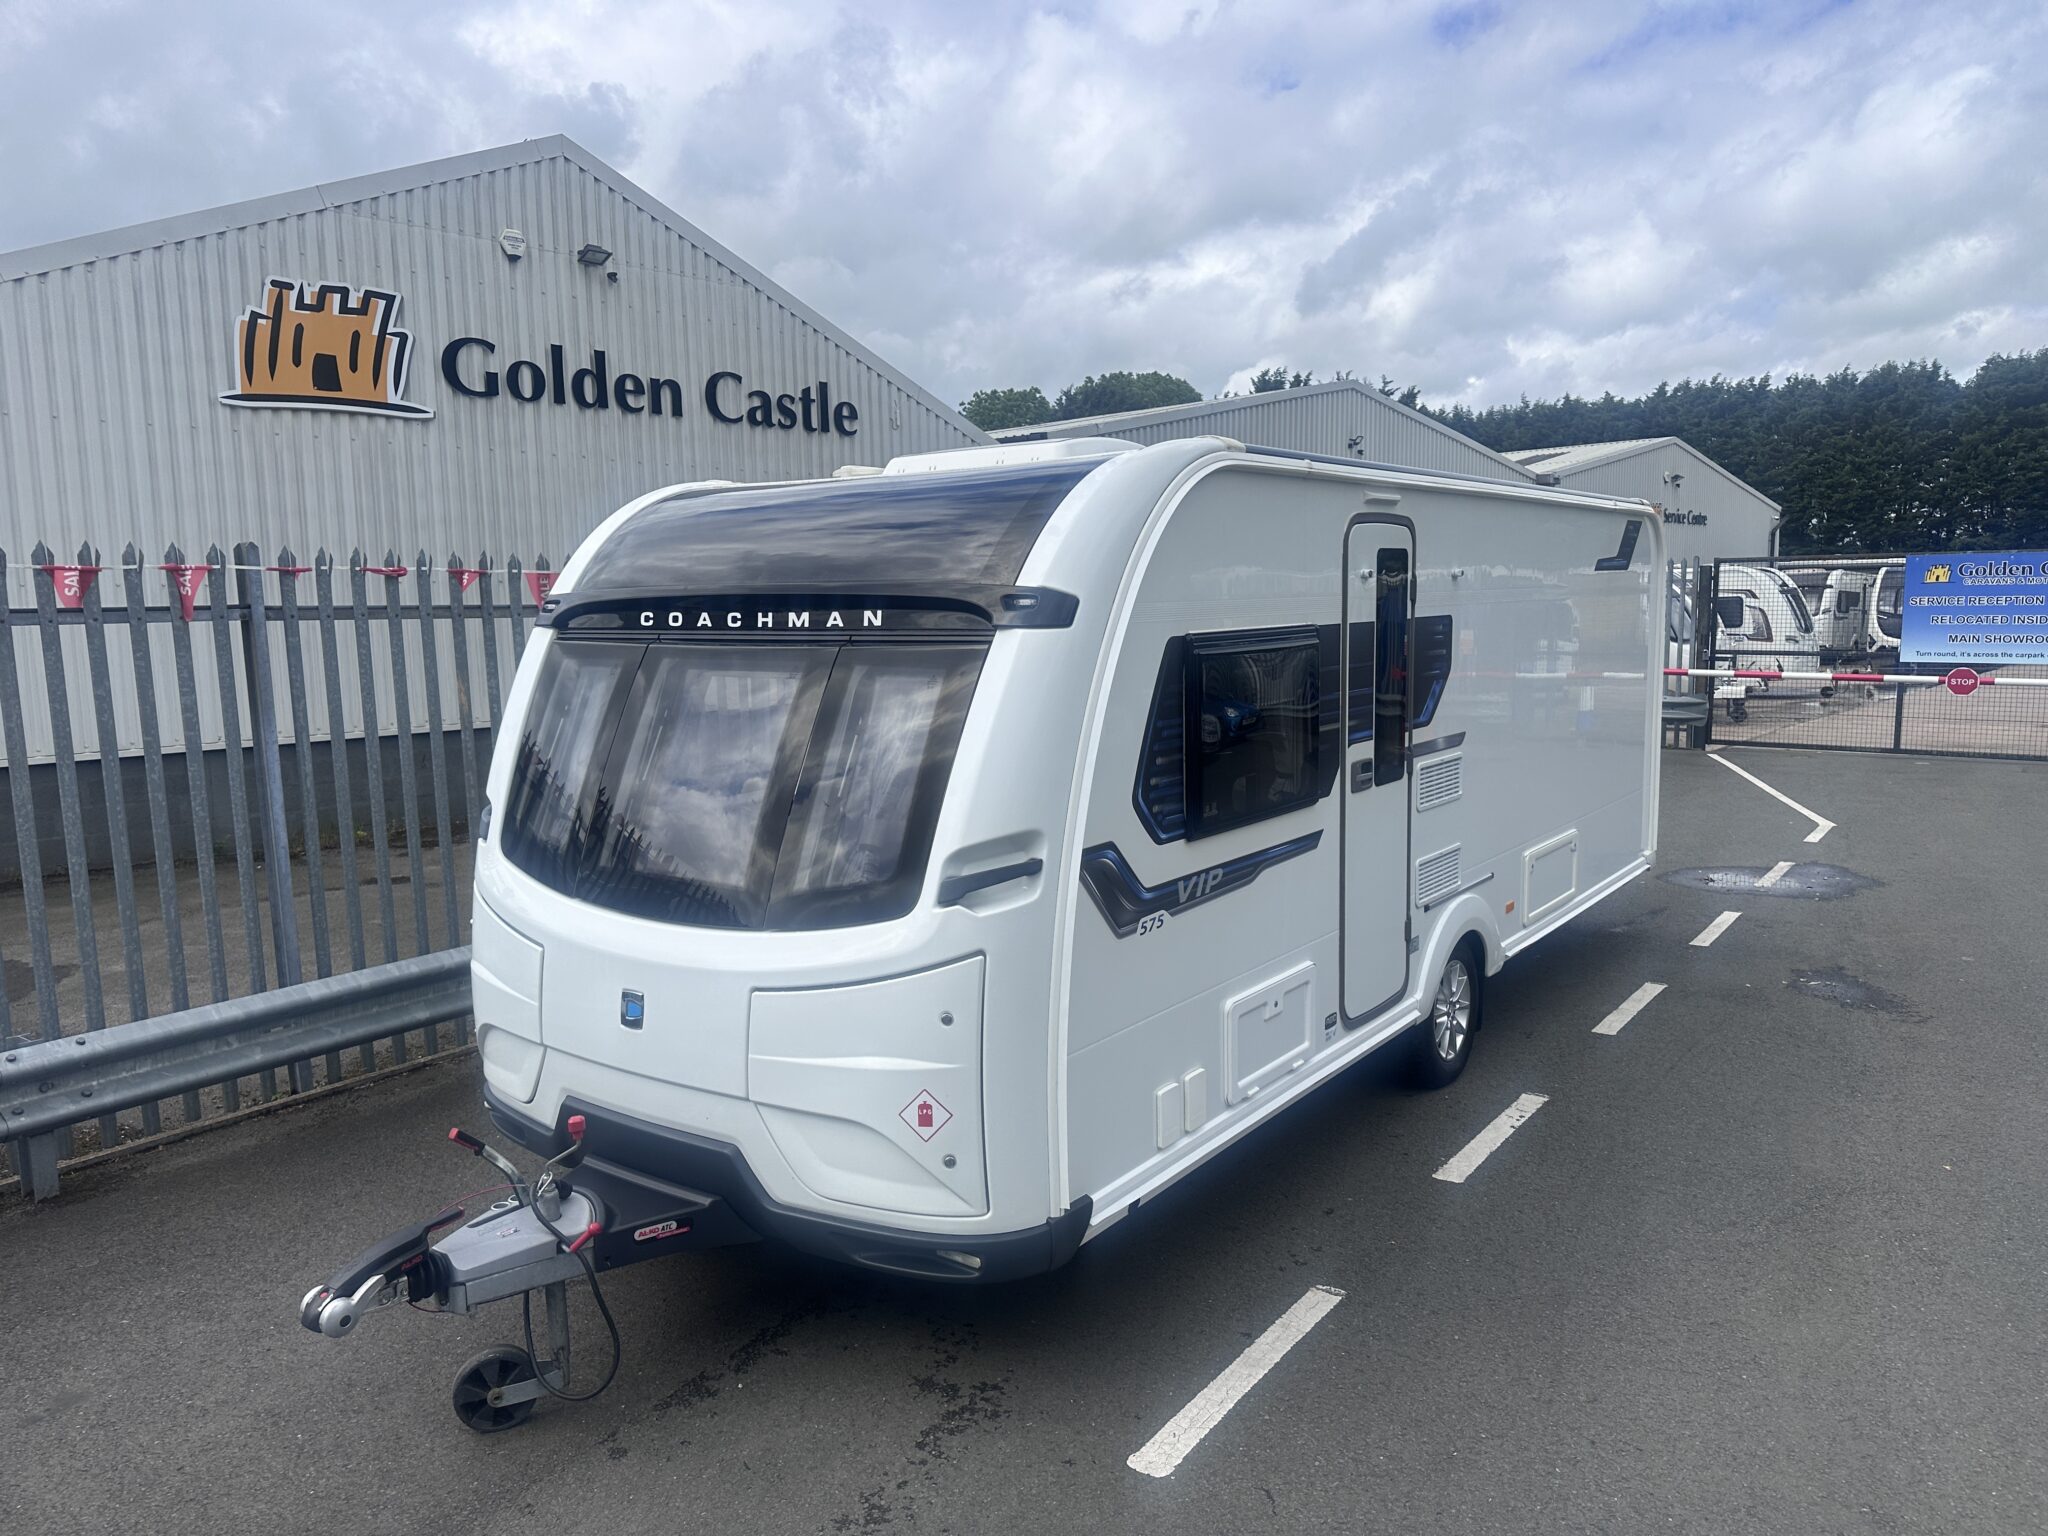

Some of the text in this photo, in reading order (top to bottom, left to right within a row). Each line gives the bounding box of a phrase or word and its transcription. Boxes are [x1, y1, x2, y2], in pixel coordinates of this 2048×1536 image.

[441, 337, 859, 436] Golden Castle
[1663, 508, 1707, 526] Service Centre
[1958, 561, 2033, 577] Golden
[1963, 577, 2015, 585] CARAVANS
[2017, 577, 2025, 585] &
[1910, 595, 2045, 606] SERVICE RECEPTION
[640, 610, 882, 628] COACHMAN
[1930, 615, 2009, 625] RELOCATED
[1948, 633, 2048, 644] MAIN SHOWRO
[1950, 678, 1975, 686] STOP
[1177, 869, 1224, 904] VIP
[1140, 914, 1165, 936] 575
[661, 1223, 675, 1232] ATC
